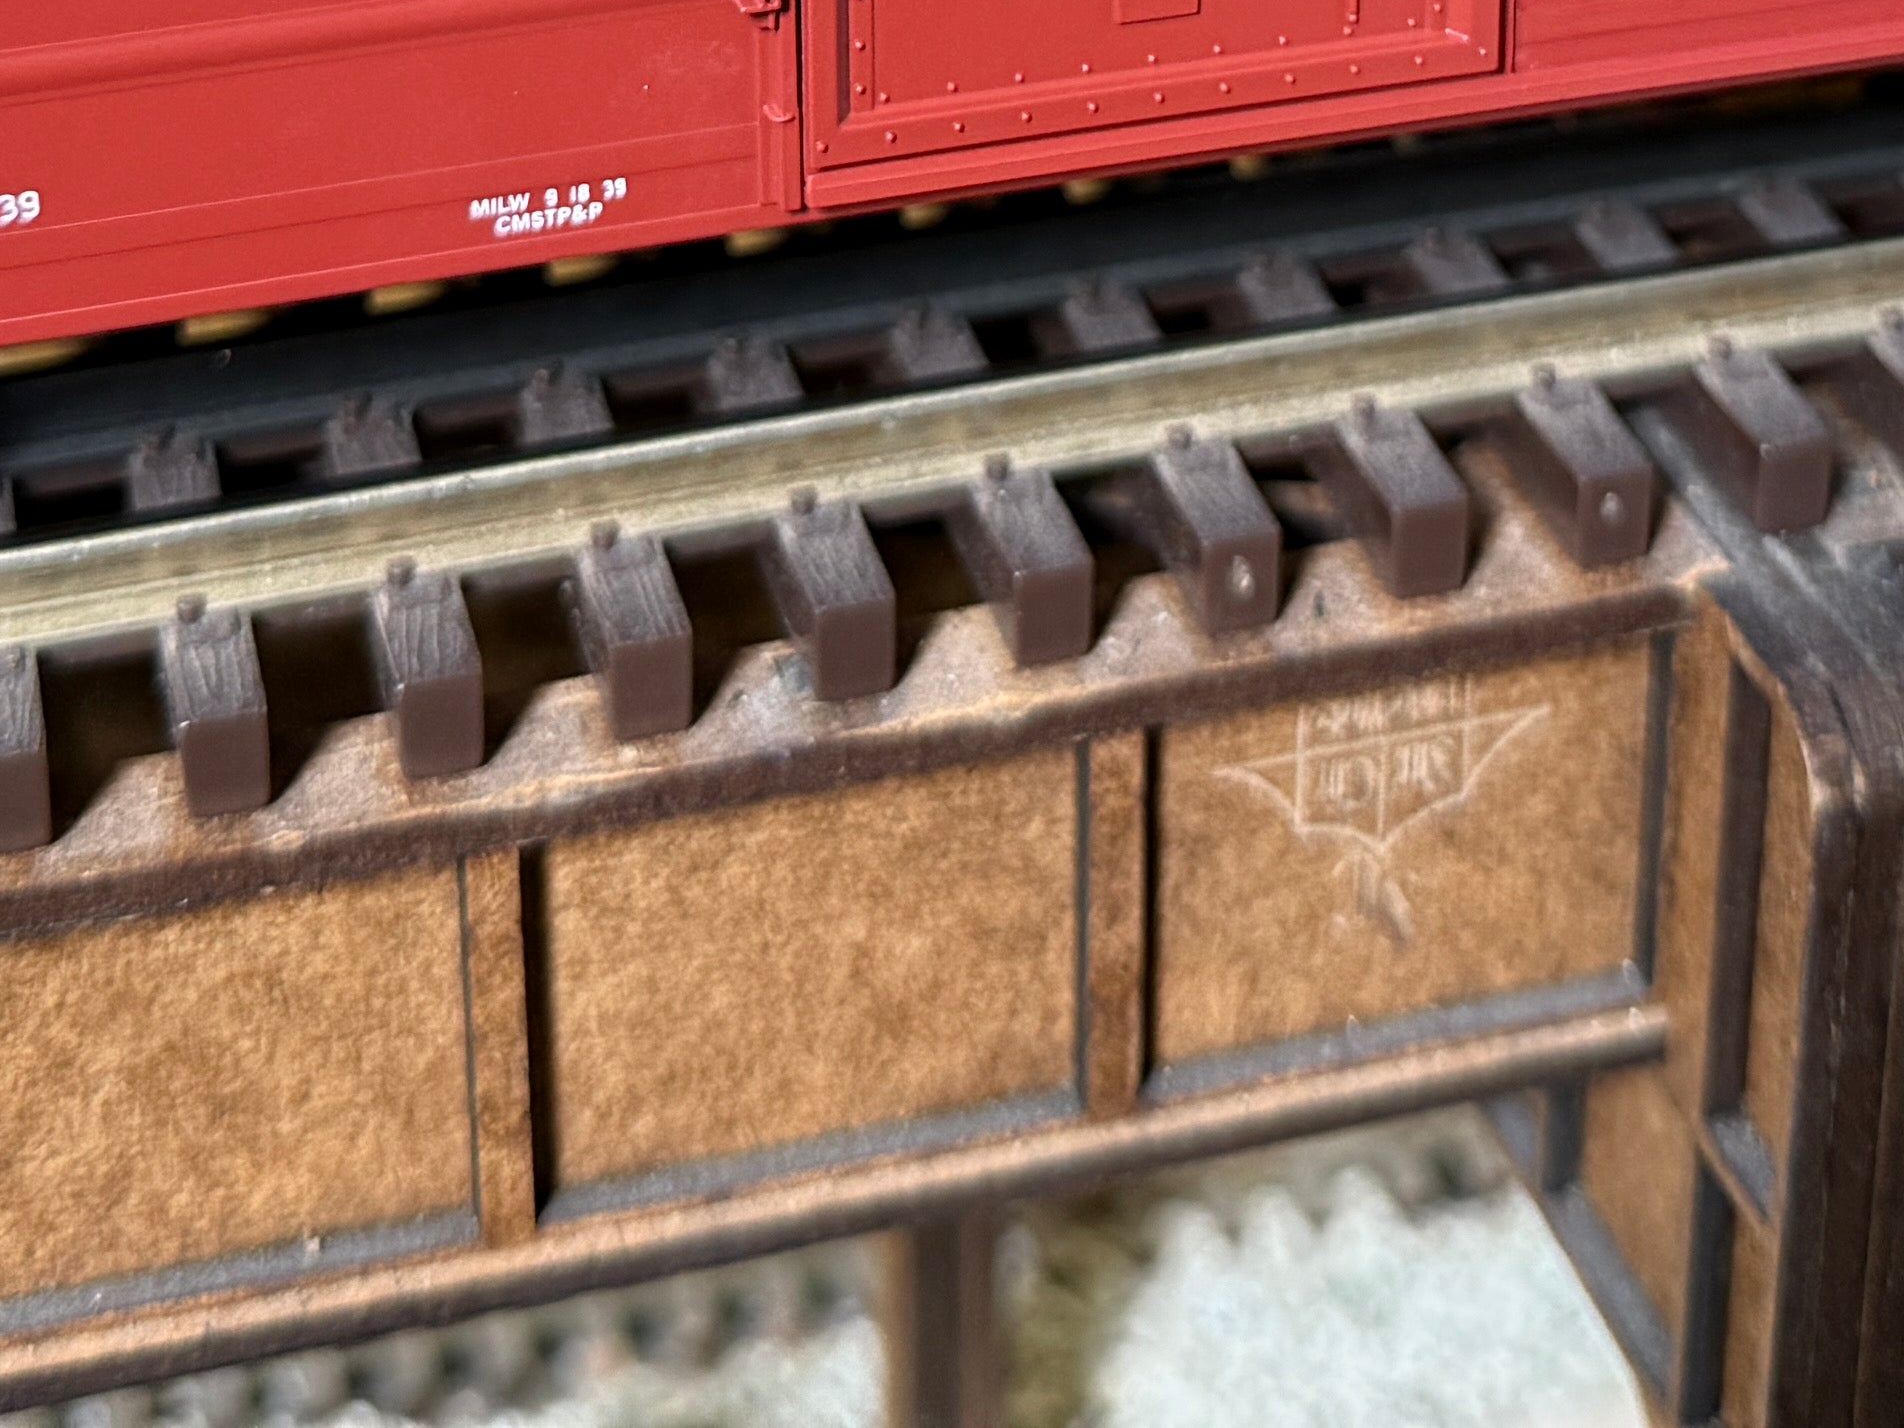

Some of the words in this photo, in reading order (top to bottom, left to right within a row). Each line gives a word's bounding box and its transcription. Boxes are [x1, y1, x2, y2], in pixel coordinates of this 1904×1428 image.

[469, 192, 531, 220] MILW
[602, 177, 628, 202] 39
[494, 201, 604, 237] CMSTP&P
